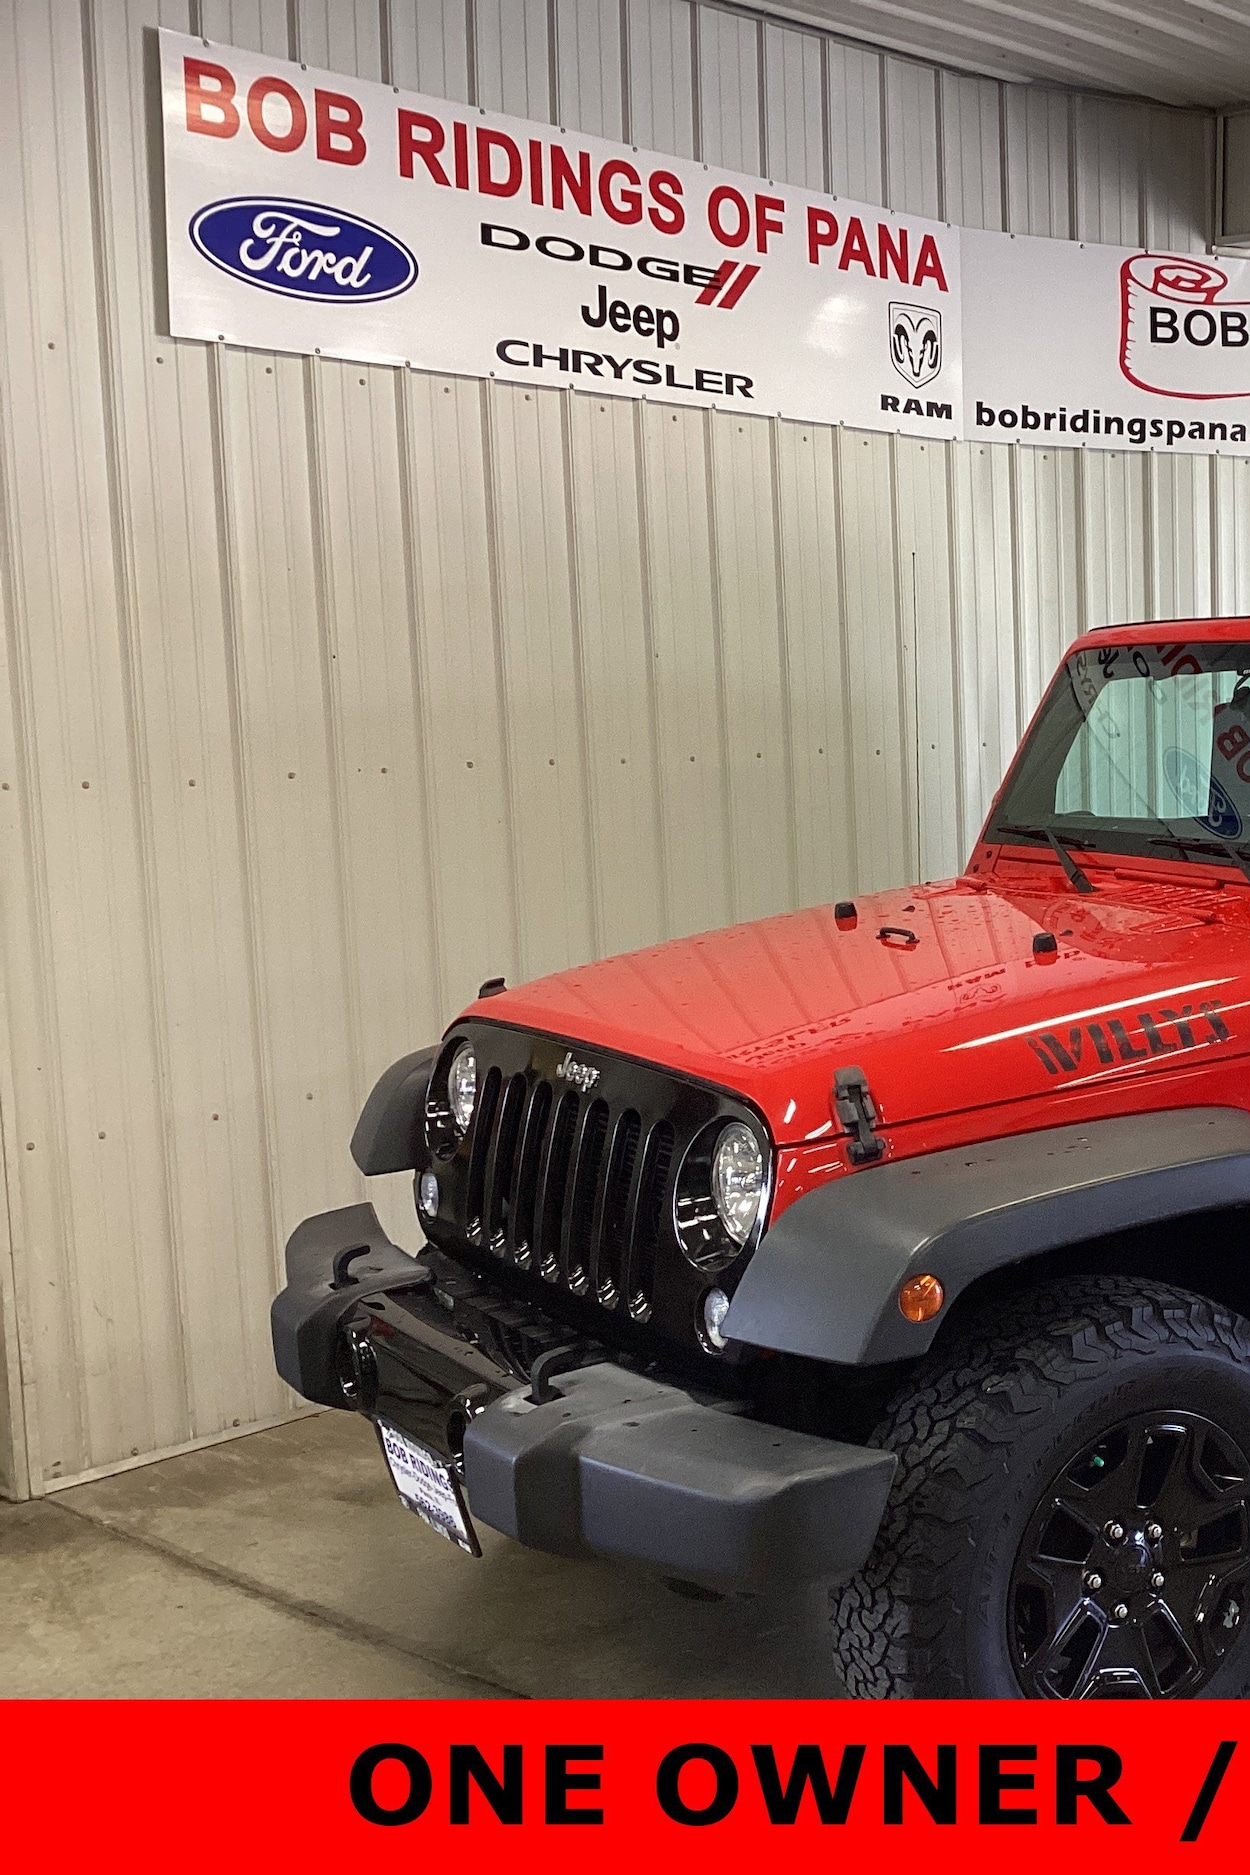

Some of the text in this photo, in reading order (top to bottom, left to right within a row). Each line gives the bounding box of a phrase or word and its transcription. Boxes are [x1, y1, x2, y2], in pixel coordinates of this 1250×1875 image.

[183, 56, 949, 292] BOB RIDINGS OF PANA
[238, 211, 374, 290] Ford
[481, 223, 722, 290] DODGE
[581, 285, 680, 349] Jeep
[1149, 306, 1249, 347] BOB
[496, 339, 755, 398] CHRYSLER
[881, 394, 952, 420] RAM
[1025, 999, 1230, 1075] WILLYS
[556, 1052, 600, 1093] Jeep
